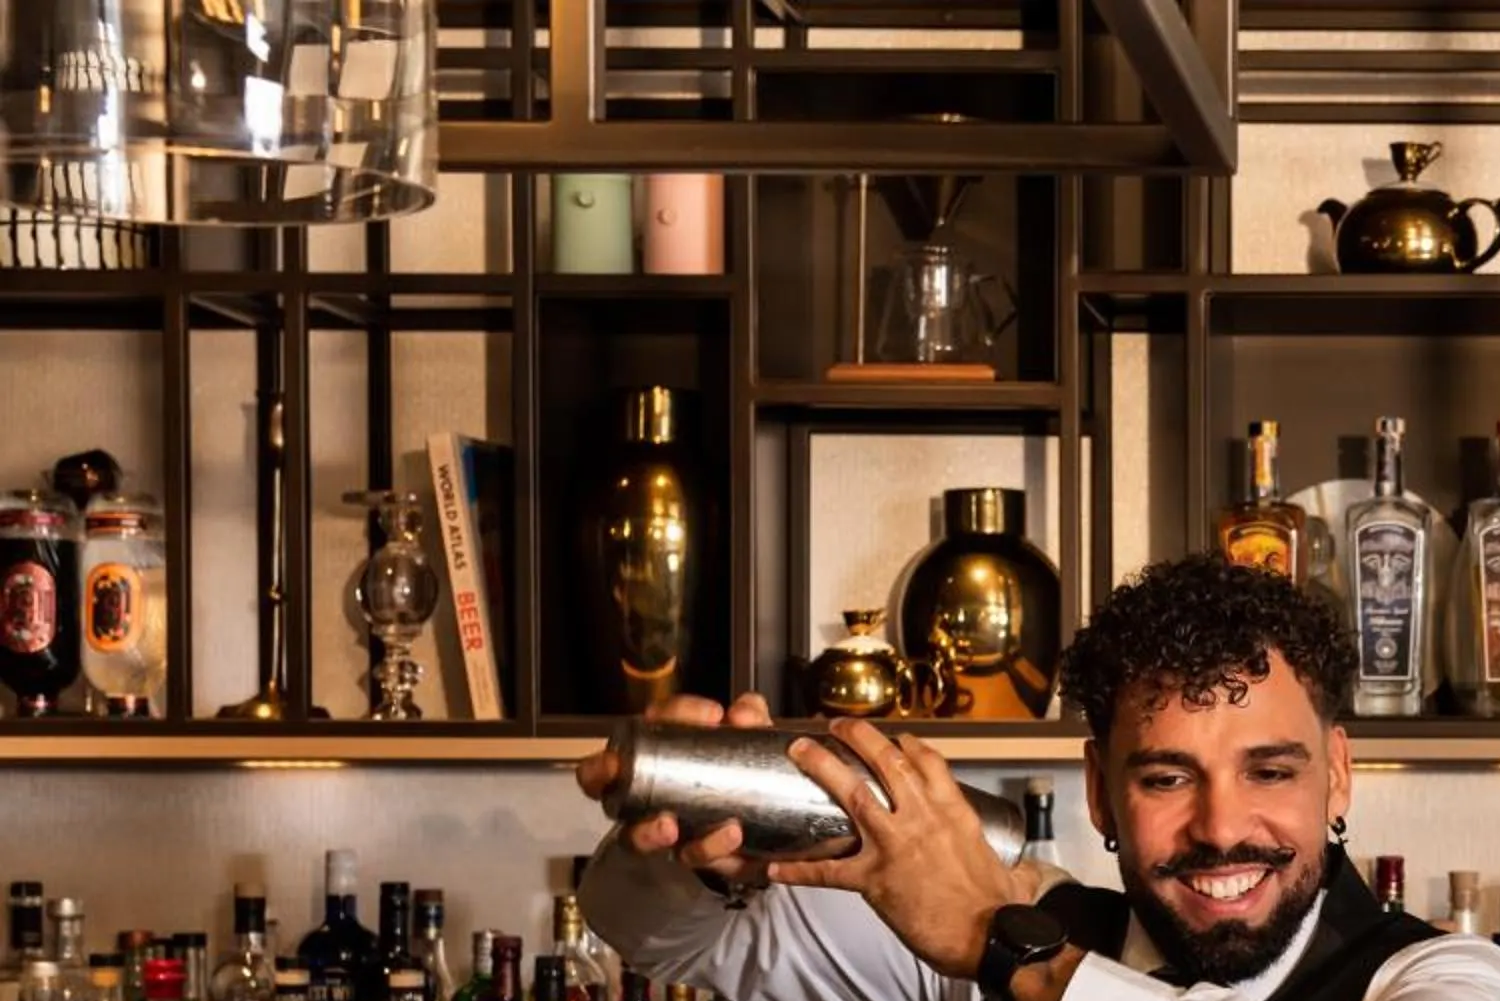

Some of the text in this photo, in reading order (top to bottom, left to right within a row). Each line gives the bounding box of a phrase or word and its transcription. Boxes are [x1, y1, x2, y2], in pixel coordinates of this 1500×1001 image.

[437, 464, 467, 570] WORLD ATLAS
[456, 591, 483, 651] BEER
